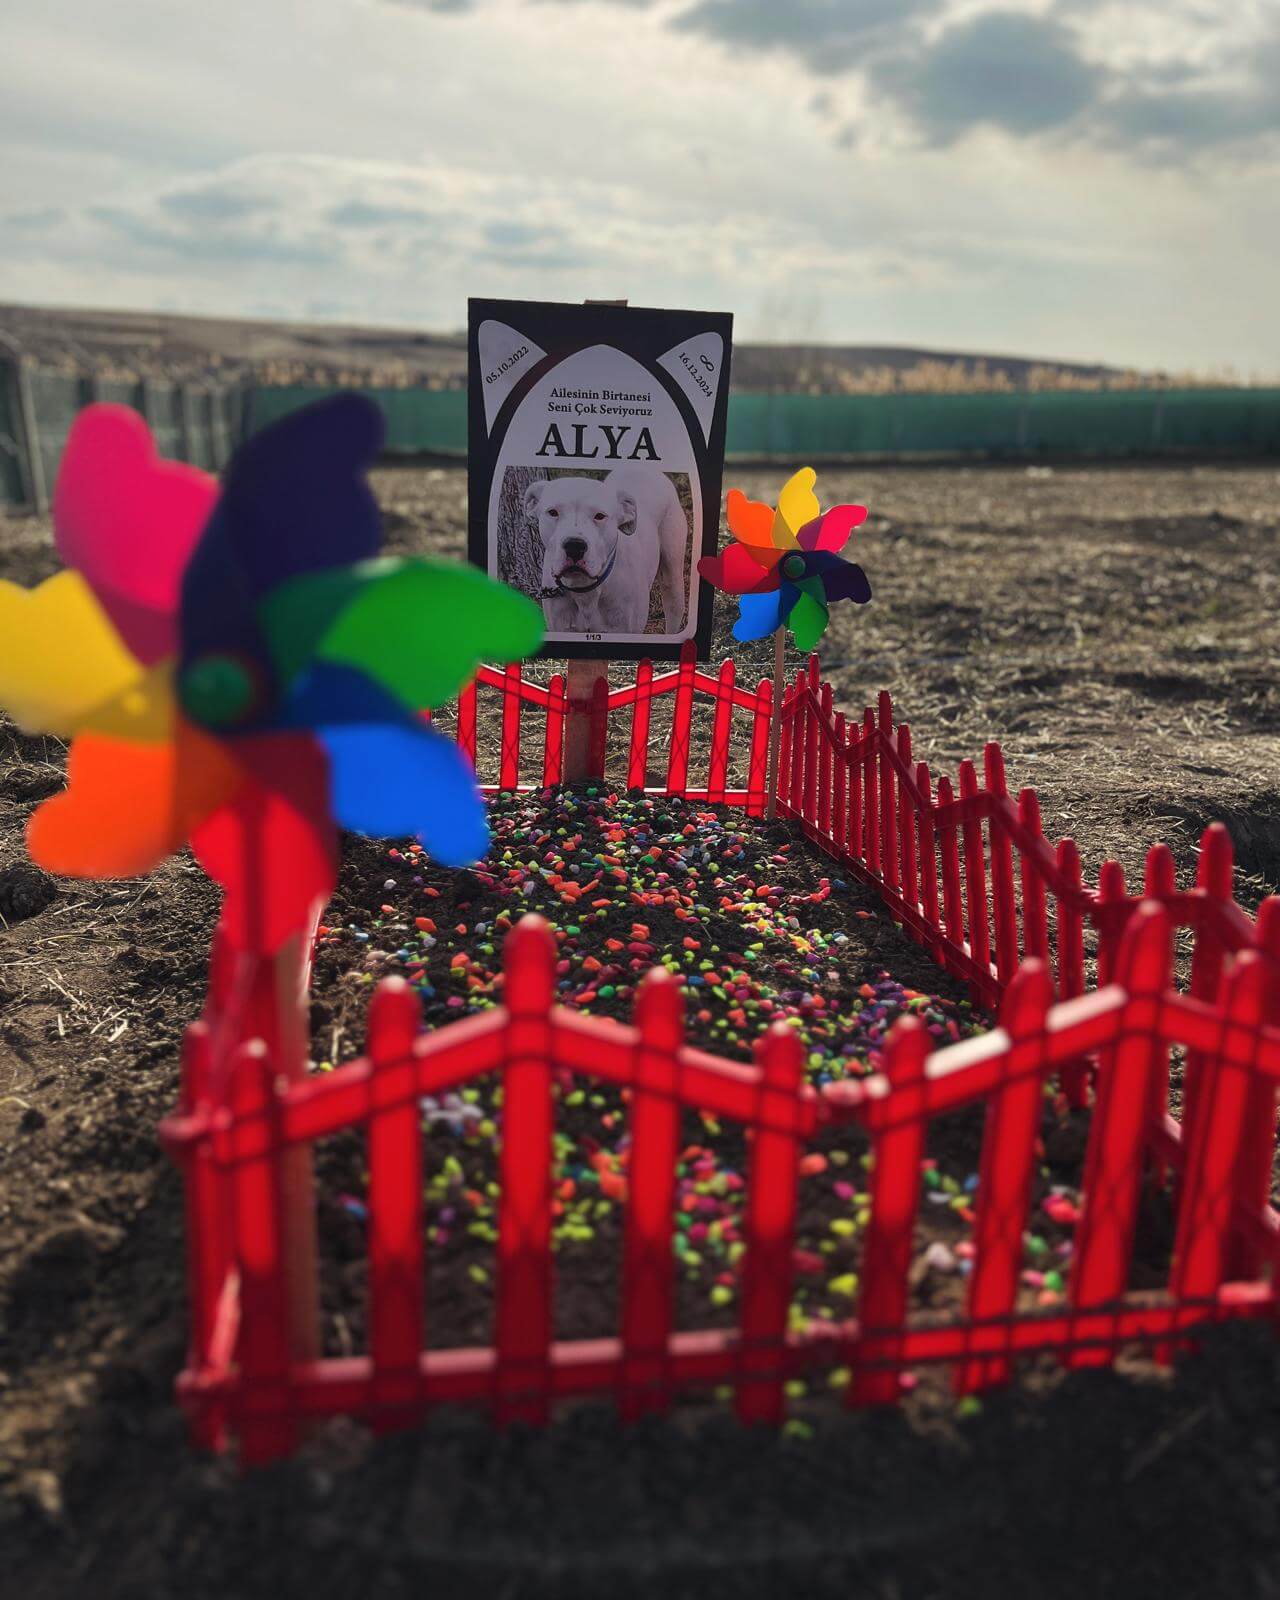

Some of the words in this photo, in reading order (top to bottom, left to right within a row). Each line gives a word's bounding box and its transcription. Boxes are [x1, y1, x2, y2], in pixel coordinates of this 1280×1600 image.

[486, 346, 529, 384] 05.10.2022
[678, 352, 713, 397] 16.12.2024
[547, 402, 572, 413] Seni
[575, 403, 598, 416] Çok
[599, 404, 653, 418] Seviyoruz
[550, 387, 599, 400] Ailesinin
[602, 390, 651, 402] Birtanesi
[536, 423, 661, 461] ALYA
